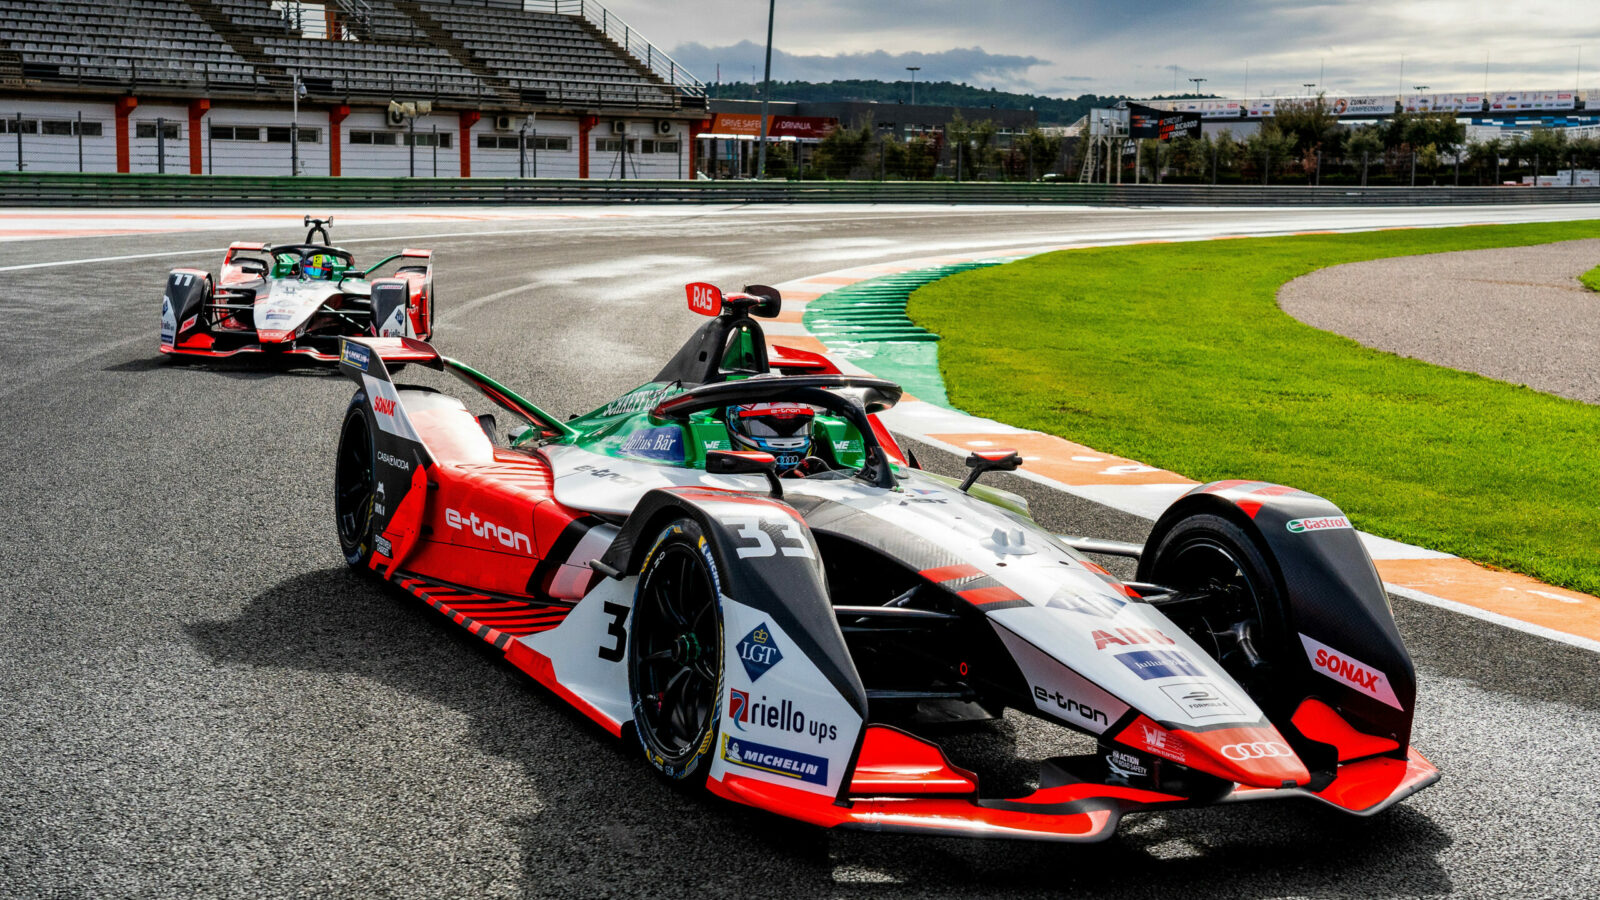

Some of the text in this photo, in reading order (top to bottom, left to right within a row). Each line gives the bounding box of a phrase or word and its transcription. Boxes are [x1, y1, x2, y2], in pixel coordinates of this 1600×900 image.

[721, 119, 741, 128] DRIVE
[174, 273, 193, 287] 11
[692, 286, 713, 310] RAS
[374, 395, 396, 417] SONAX
[623, 434, 677, 451] Julius Bär
[445, 507, 532, 554] e-tron
[1303, 517, 1349, 530] Castrol
[721, 517, 816, 560] 33
[598, 600, 631, 663] 3
[1091, 627, 1176, 650] ABB
[741, 640, 777, 666] LGT
[1314, 648, 1380, 693] SONAX
[1033, 685, 1109, 727] e-tron
[751, 695, 838, 744] riello ups
[743, 750, 820, 776] MICHELIN
[1120, 752, 1140, 766] ACTION
